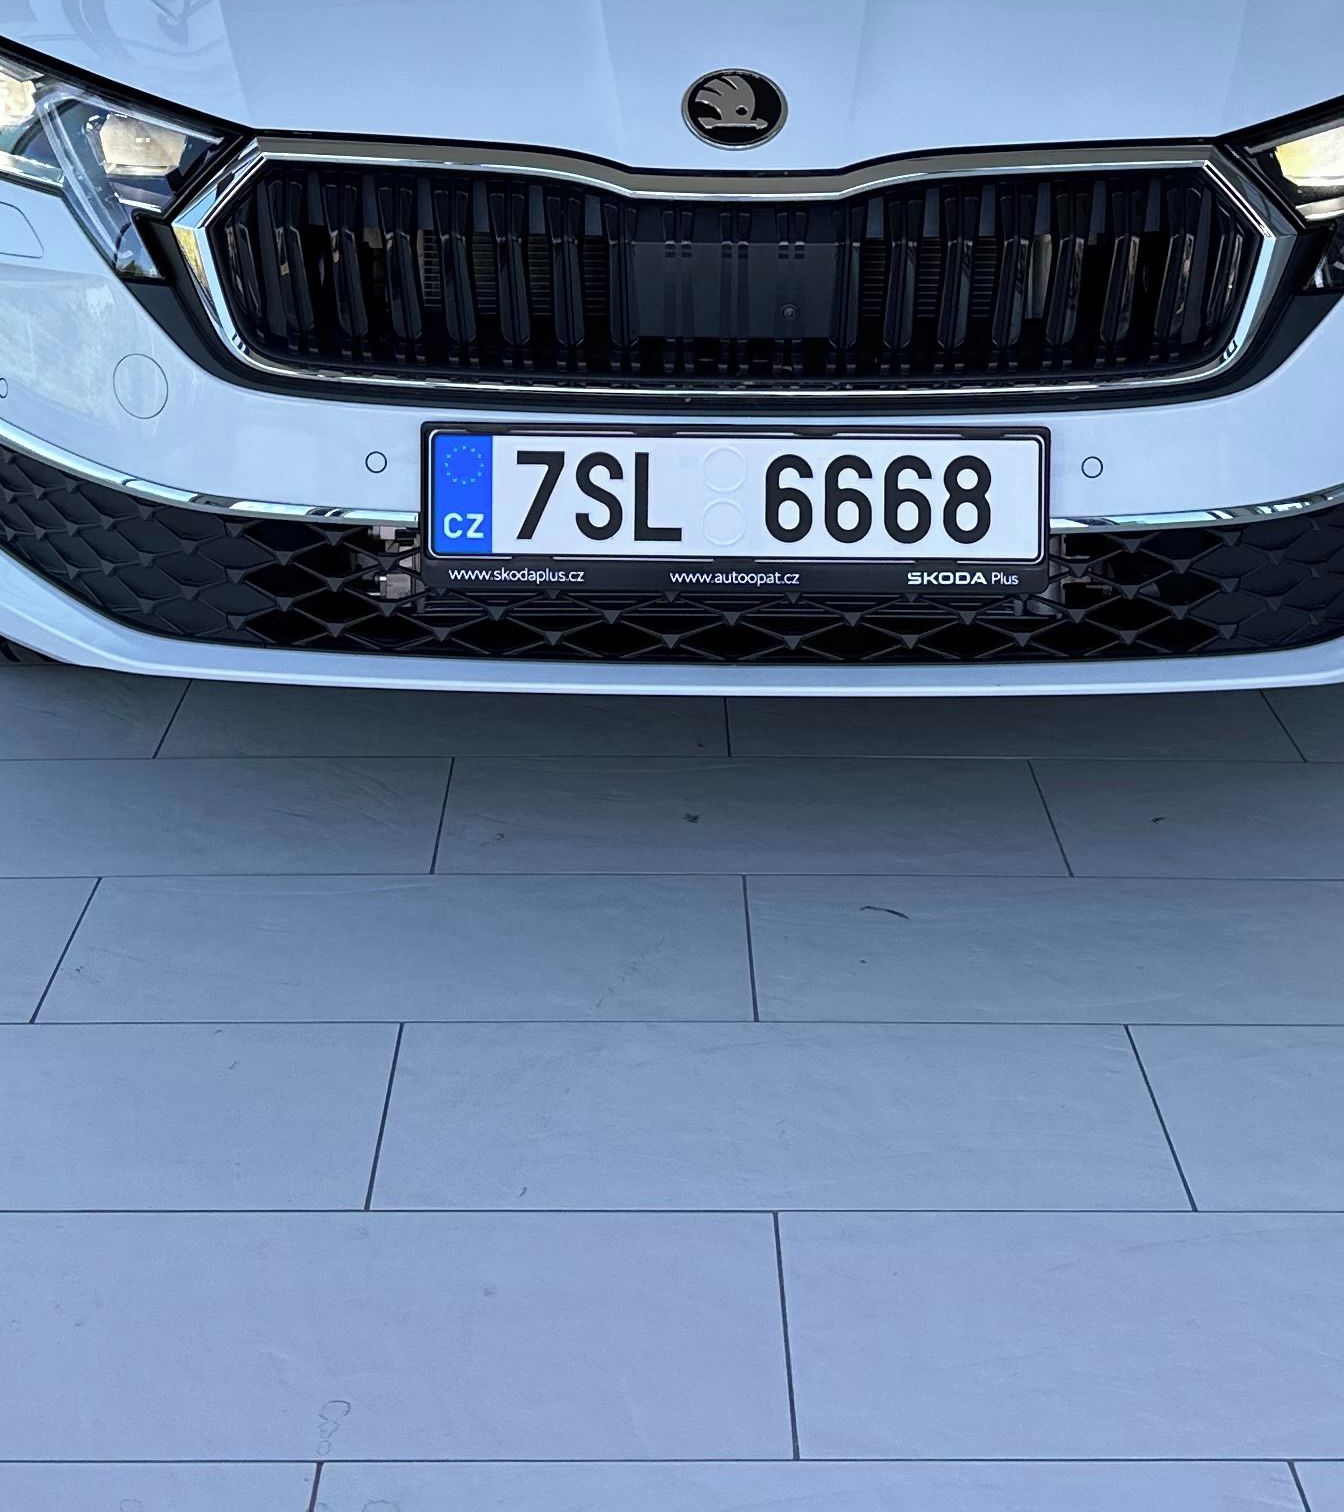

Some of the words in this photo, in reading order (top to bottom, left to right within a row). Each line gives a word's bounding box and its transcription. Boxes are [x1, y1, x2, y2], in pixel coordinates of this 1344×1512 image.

[516, 450, 682, 541] 7SL
[765, 453, 992, 544] 6668
[442, 511, 485, 539] CZ
[448, 567, 585, 585] www.skodaplus.cz
[669, 571, 800, 587] www.autoopat.cz
[991, 571, 1019, 585] Plus
